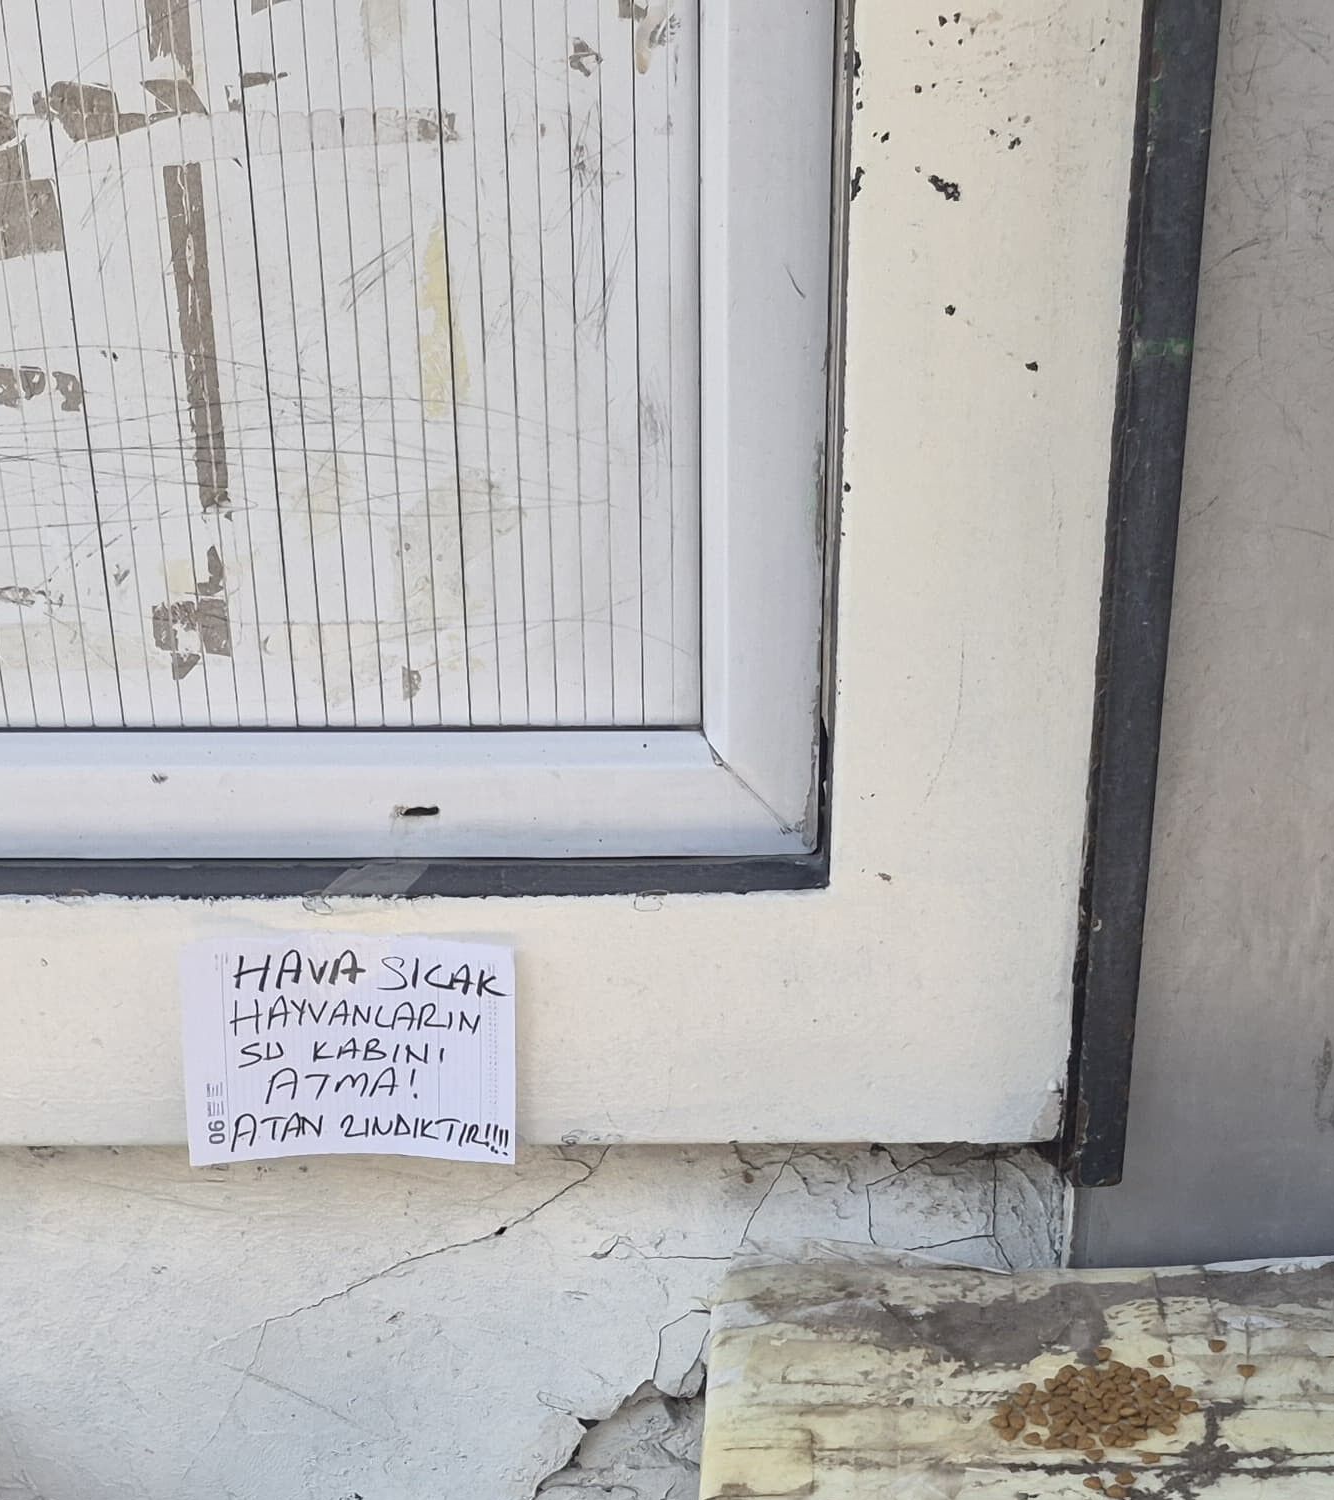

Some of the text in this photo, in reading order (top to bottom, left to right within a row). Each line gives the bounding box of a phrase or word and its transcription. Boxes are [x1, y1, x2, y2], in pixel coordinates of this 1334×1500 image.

[233, 949, 512, 997] HAVA SICAK
[229, 995, 481, 1036] HAYVANLARIN
[238, 1042, 285, 1068] SU
[265, 1066, 419, 1104] ATMA!
[230, 1112, 324, 1153] ATAN
